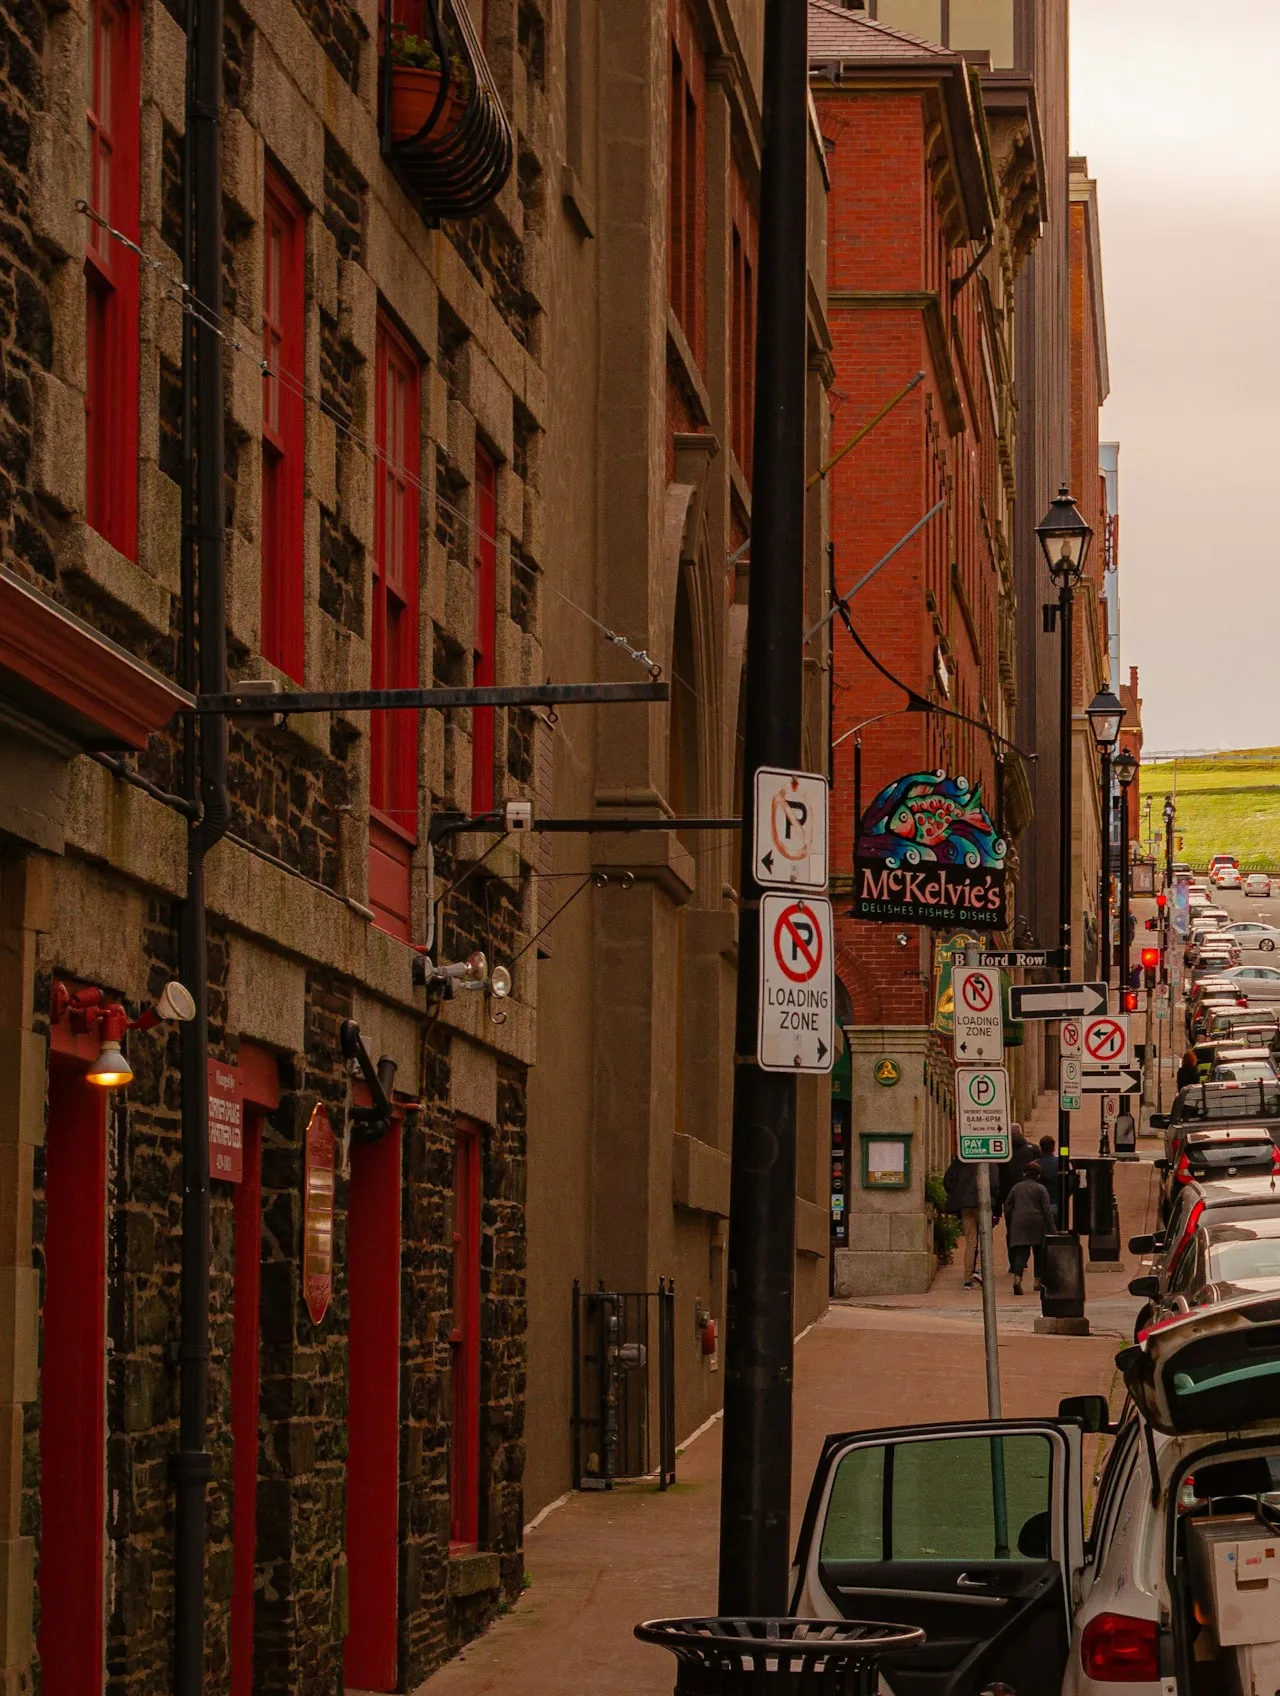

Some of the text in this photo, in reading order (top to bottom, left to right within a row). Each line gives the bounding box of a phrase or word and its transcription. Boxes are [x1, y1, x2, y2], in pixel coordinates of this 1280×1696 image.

[860, 868, 1001, 909] McKelvie's
[862, 902, 914, 916] DELISHES
[960, 910, 998, 922] DISHES
[954, 953, 1009, 966] Bford
[1016, 953, 1044, 966] Row
[767, 987, 828, 1009] LOADING
[780, 1011, 819, 1031] ZONE
[957, 1015, 999, 1026] LOADING
[966, 1026, 992, 1037] ZONE
[966, 1115, 1002, 1123] 8AM-6PM
[964, 1139, 983, 1148] PAY
[993, 1140, 1003, 1152] B
